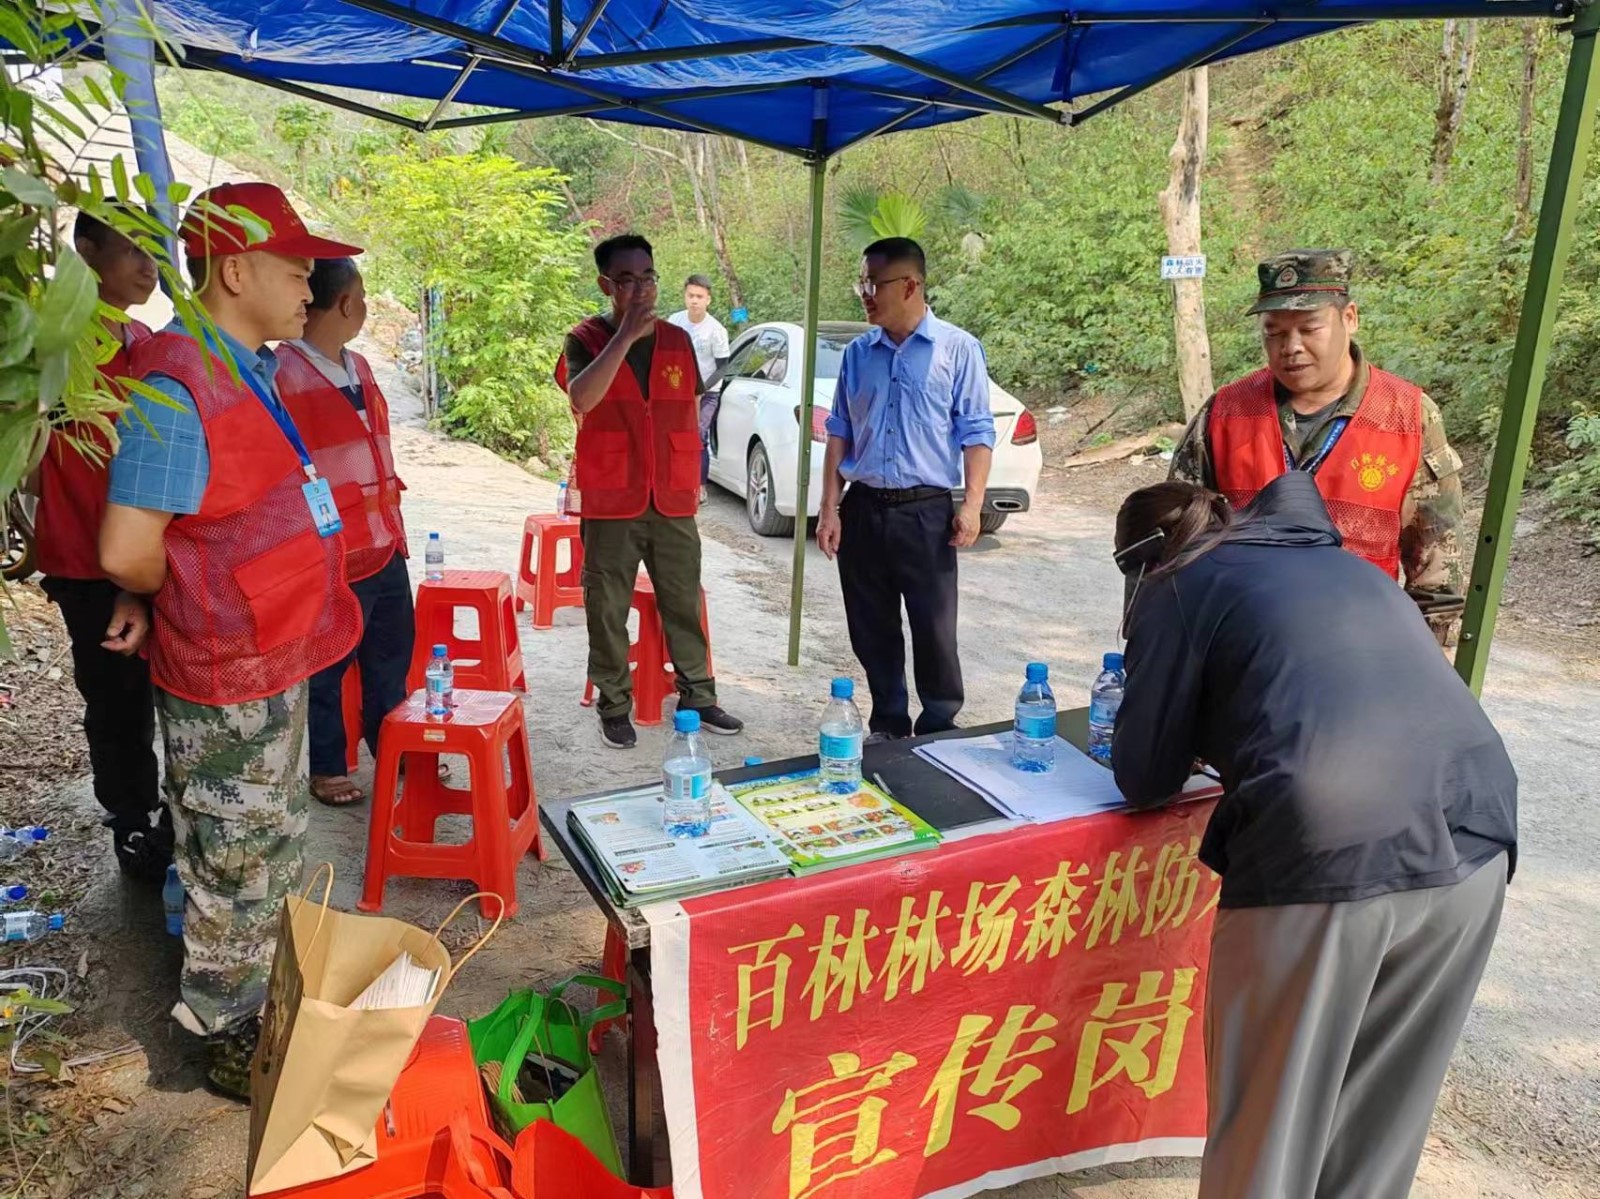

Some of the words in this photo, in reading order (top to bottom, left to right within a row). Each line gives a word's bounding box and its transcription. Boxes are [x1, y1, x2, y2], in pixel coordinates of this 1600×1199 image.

[728, 836, 1222, 1050] 百林林场森林防
[772, 967, 1199, 1199] 宣传岗
